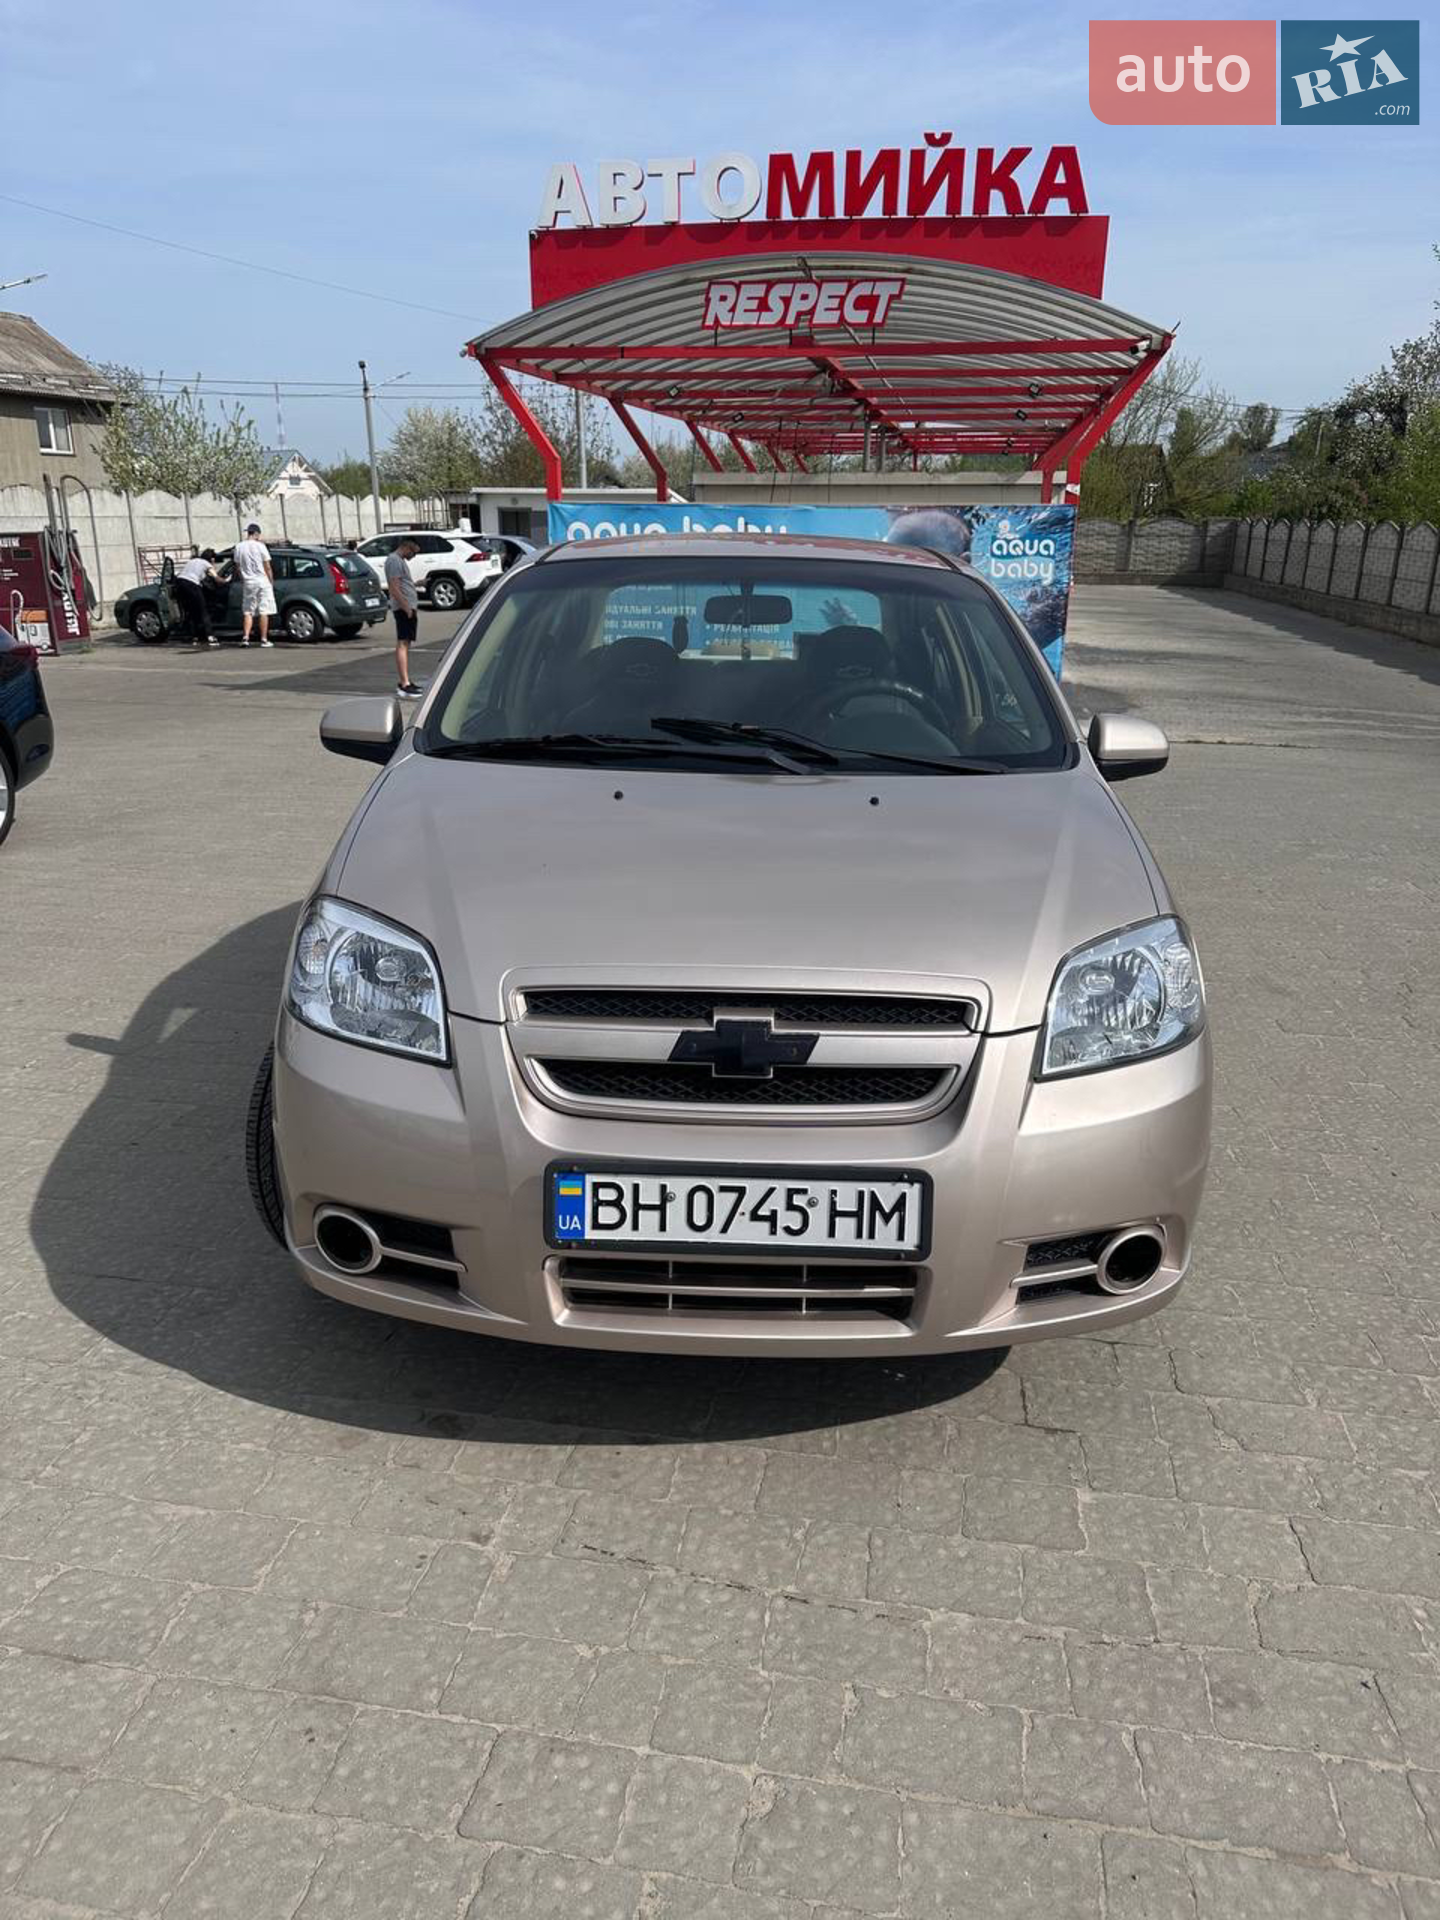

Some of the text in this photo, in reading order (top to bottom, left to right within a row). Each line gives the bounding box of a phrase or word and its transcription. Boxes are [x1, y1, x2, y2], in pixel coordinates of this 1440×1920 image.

[536, 132, 1090, 228] АВТОМИЙКА
[703, 279, 905, 329] RESPECT
[992, 538, 1055, 556] aqua
[990, 558, 1054, 586] baby
[558, 1215, 582, 1230] UA
[591, 1181, 908, 1242] BH 0745 HM
